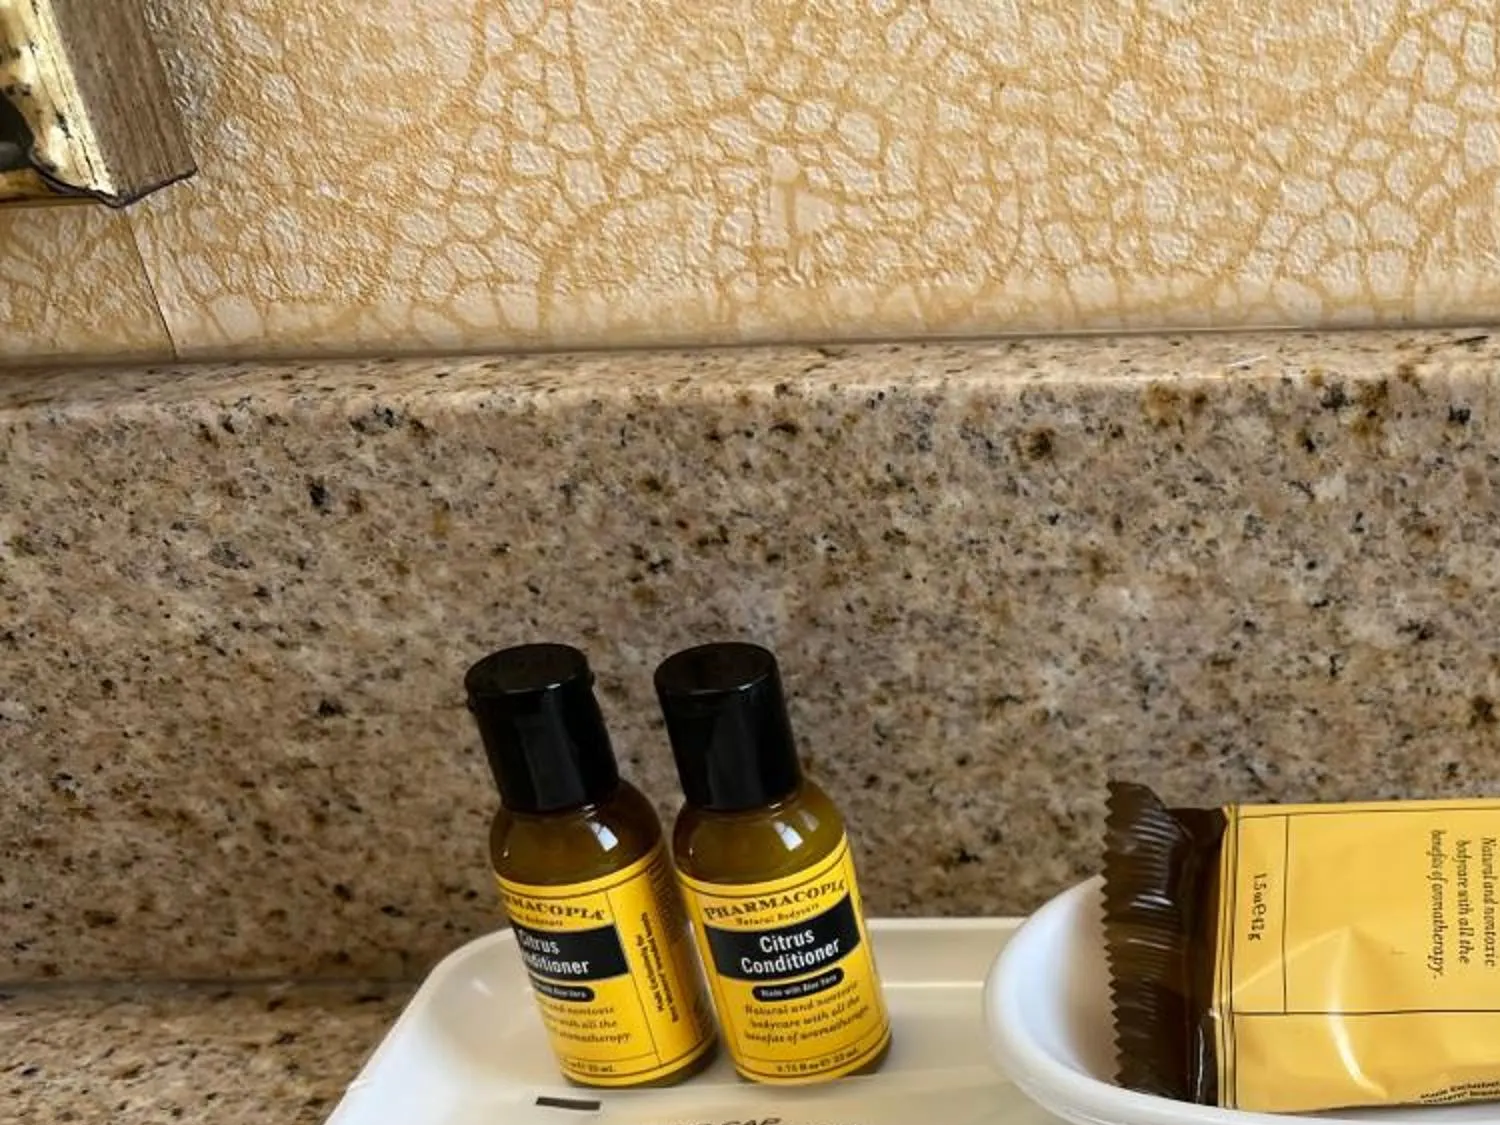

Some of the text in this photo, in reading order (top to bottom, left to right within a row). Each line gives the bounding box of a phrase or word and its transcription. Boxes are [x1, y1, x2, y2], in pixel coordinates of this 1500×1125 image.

[740, 938, 840, 975] Conditioner
[759, 928, 815, 954] Citrus
[1425, 829, 1449, 980] benefits of aromatherapy.
[1451, 839, 1475, 965] bodycare with all the
[1481, 837, 1499, 968] Natural and nontoxic
